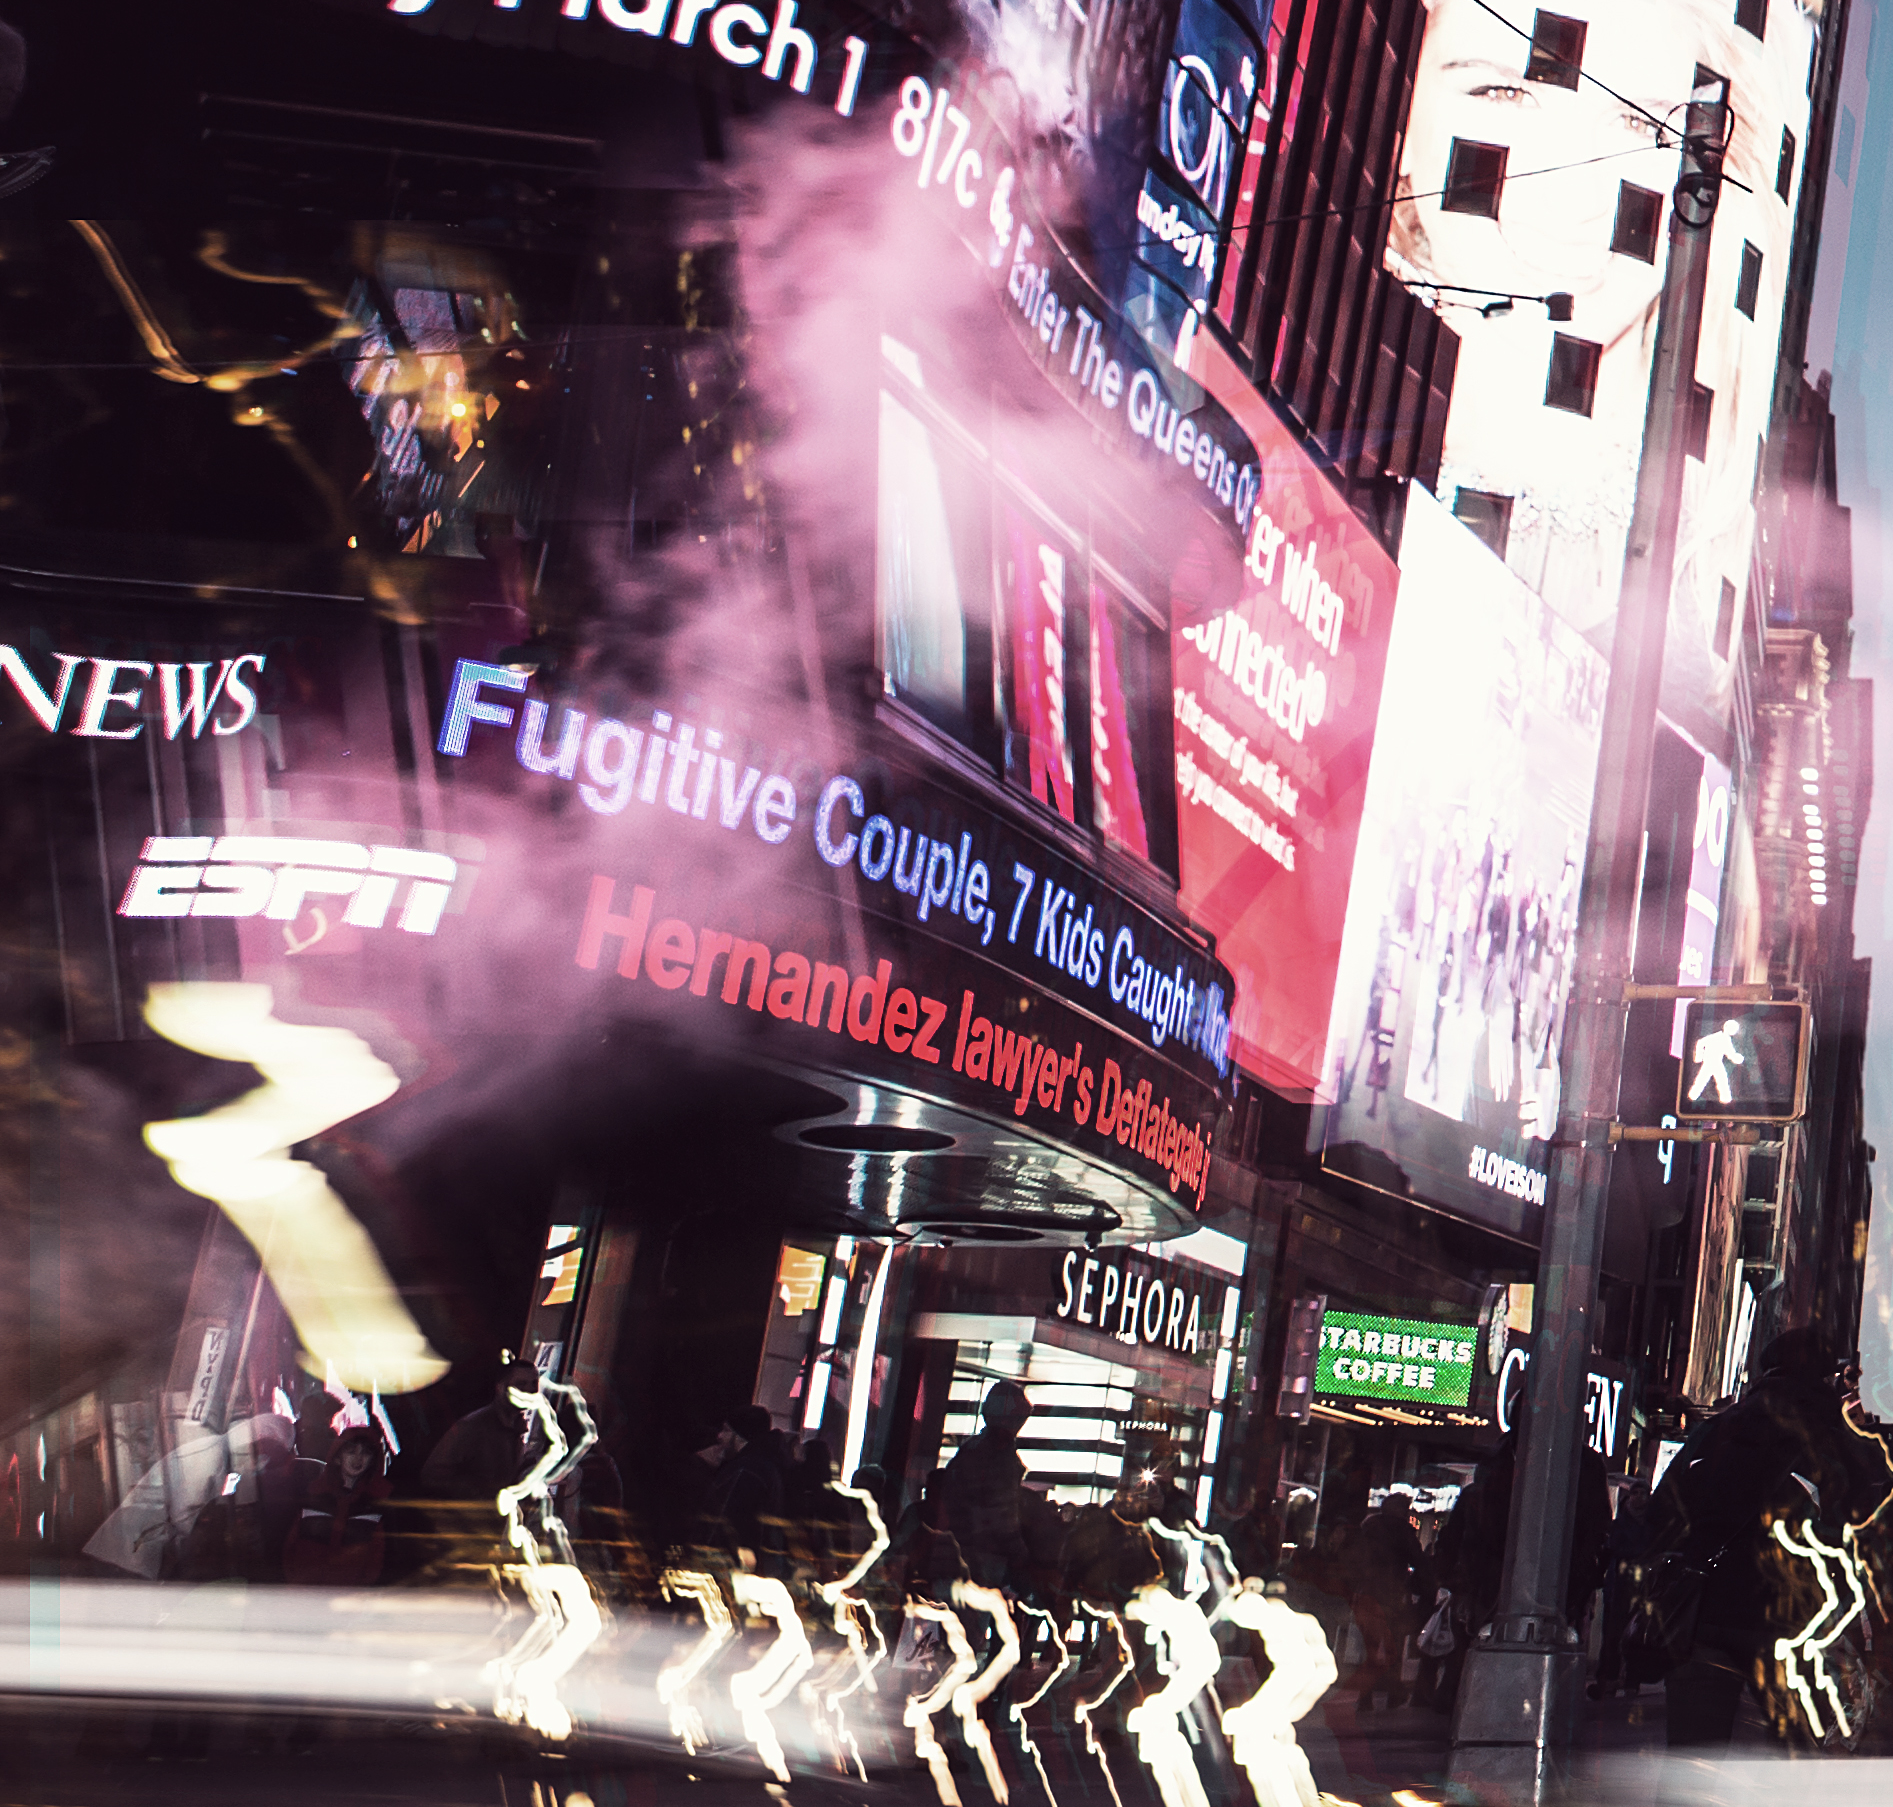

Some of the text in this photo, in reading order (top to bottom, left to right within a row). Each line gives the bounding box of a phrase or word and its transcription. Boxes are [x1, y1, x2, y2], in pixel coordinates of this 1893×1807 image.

[834, 34, 868, 116] 1
[1067, 304, 1123, 410] The
[1127, 367, 1236, 508] Queens
[0, 644, 267, 741] NEWS
[116, 834, 457, 936] ESPN
[437, 658, 796, 845] Fugitive
[813, 774, 998, 946] Couple,
[1007, 861, 1036, 944] 7
[1034, 878, 1106, 988] Kids
[1109, 925, 1197, 1047] Caught
[576, 873, 948, 1065] Hernandez
[951, 989, 1094, 1126] lawyer's
[1056, 1250, 1200, 1355] SEPHORA
[1333, 1357, 1437, 1389] COFFEE
[1119, 1420, 1168, 1433] SEPHORA
